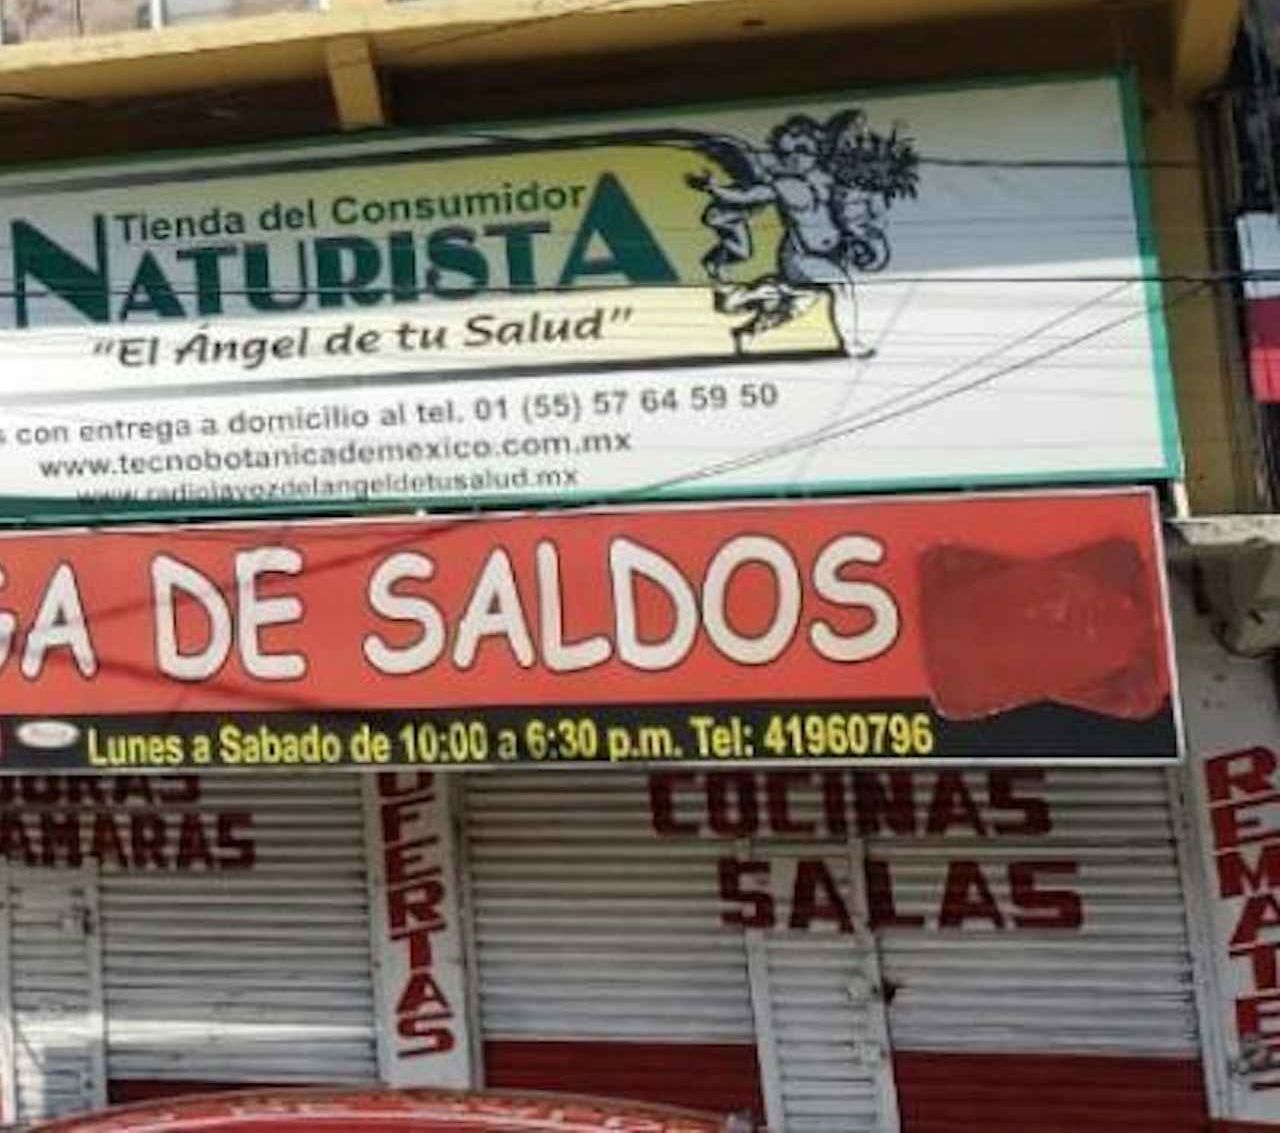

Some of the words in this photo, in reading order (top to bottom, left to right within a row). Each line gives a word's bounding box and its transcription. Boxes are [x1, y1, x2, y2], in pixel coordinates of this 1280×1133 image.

[115, 209, 243, 245] Tienda
[258, 197, 318, 233] del
[331, 182, 587, 226] Consumidor
[10, 170, 681, 328] NATURISTA
[175, 322, 309, 369] Ángel
[325, 325, 385, 354] de
[396, 323, 448, 351] tu
[15, 425, 70, 445] con
[79, 417, 192, 445] entrega
[200, 418, 218, 436] a
[228, 406, 370, 434] domicilio
[379, 403, 406, 428] al
[416, 400, 464, 425] tel.
[473, 396, 509, 421] 01
[522, 392, 582, 423] (55)
[592, 389, 628, 415] 57
[640, 387, 679, 413] 64
[689, 385, 729, 410] 59
[739, 382, 779, 408] 50
[40, 431, 633, 478] www.tecnobotanicademexico.com.mx
[148, 545, 309, 682] DE
[361, 532, 902, 676] SALDOS
[87, 726, 182, 766] Lunes
[192, 732, 212, 764] a
[218, 722, 342, 764] Sabado
[349, 722, 393, 763] de
[398, 720, 488, 763] 10:00
[497, 728, 519, 761] a
[525, 718, 599, 761] 6:30
[608, 722, 684, 763] p.m.
[690, 716, 754, 758] Tel:
[763, 713, 935, 757] 41960796
[647, 770, 1055, 839] COCINAS
[716, 857, 1085, 934] SALAS
